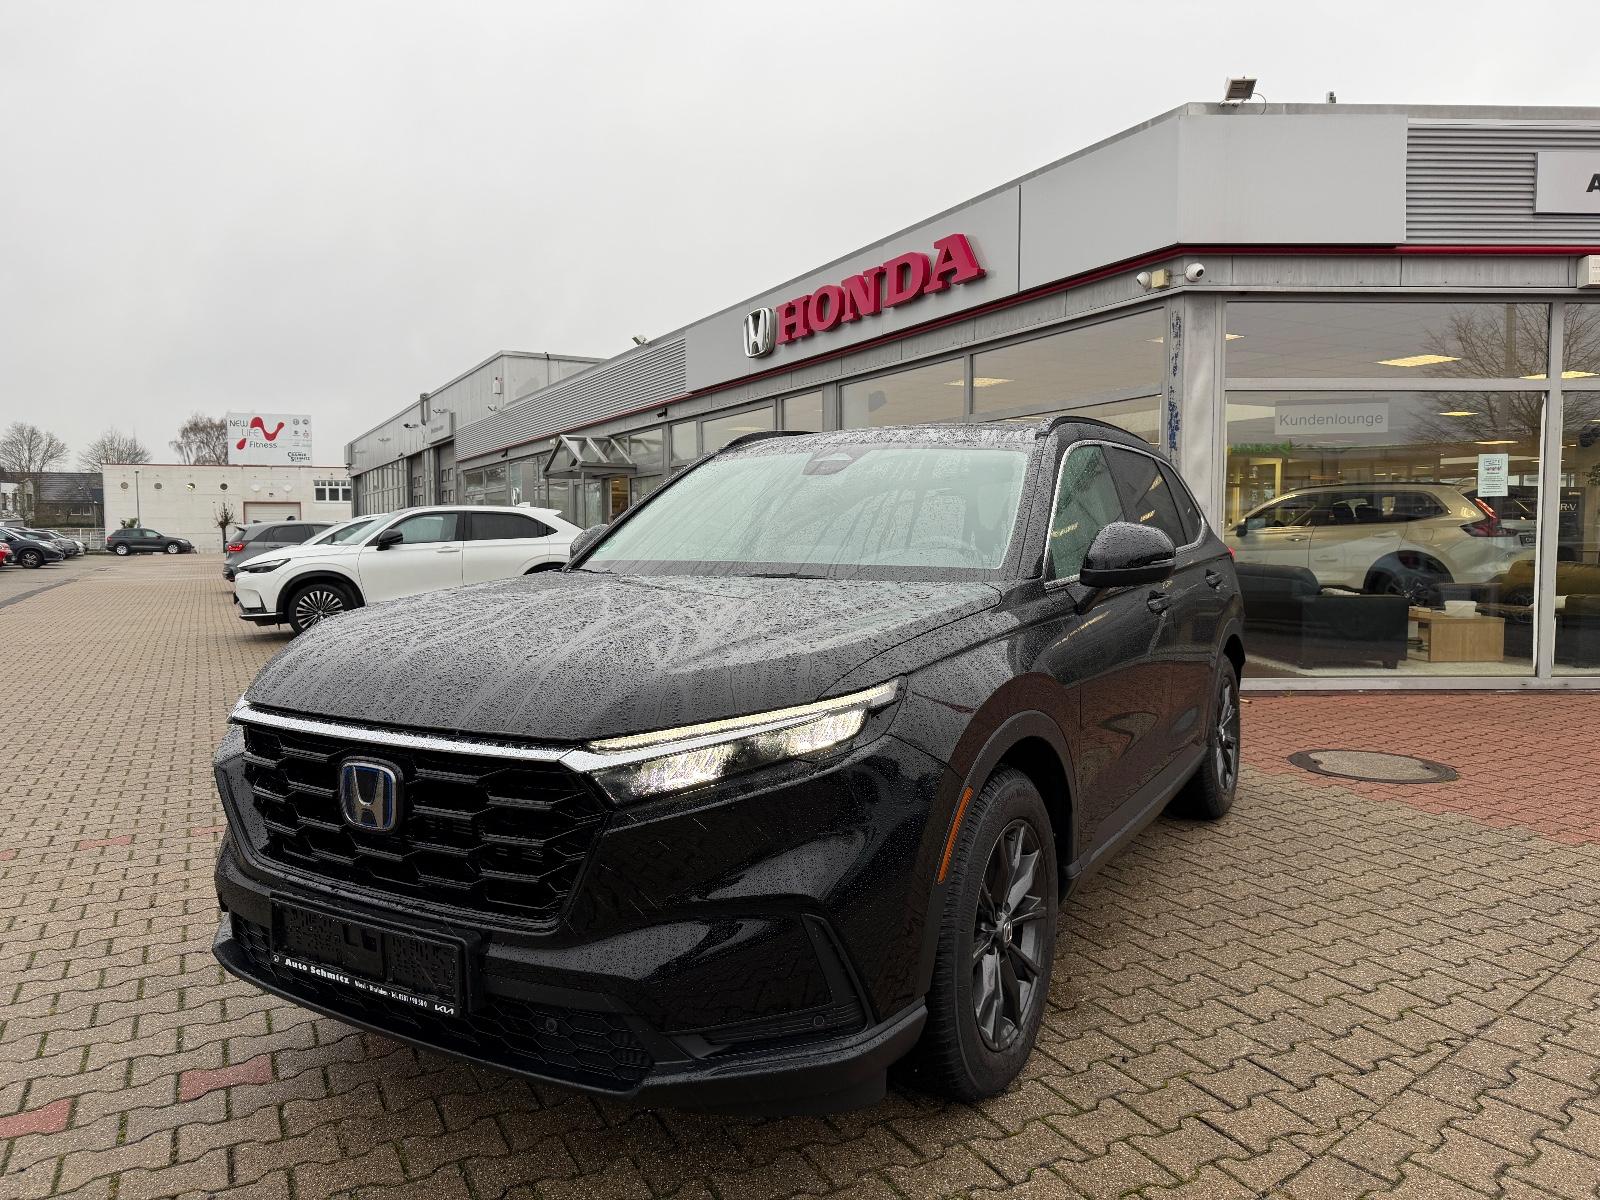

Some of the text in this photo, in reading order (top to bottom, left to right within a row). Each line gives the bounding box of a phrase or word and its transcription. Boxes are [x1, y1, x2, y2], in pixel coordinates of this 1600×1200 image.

[775, 233, 986, 346] HONDA
[1280, 413, 1384, 427] Kundenlounge
[285, 958, 350, 985] Auto Schmitz
